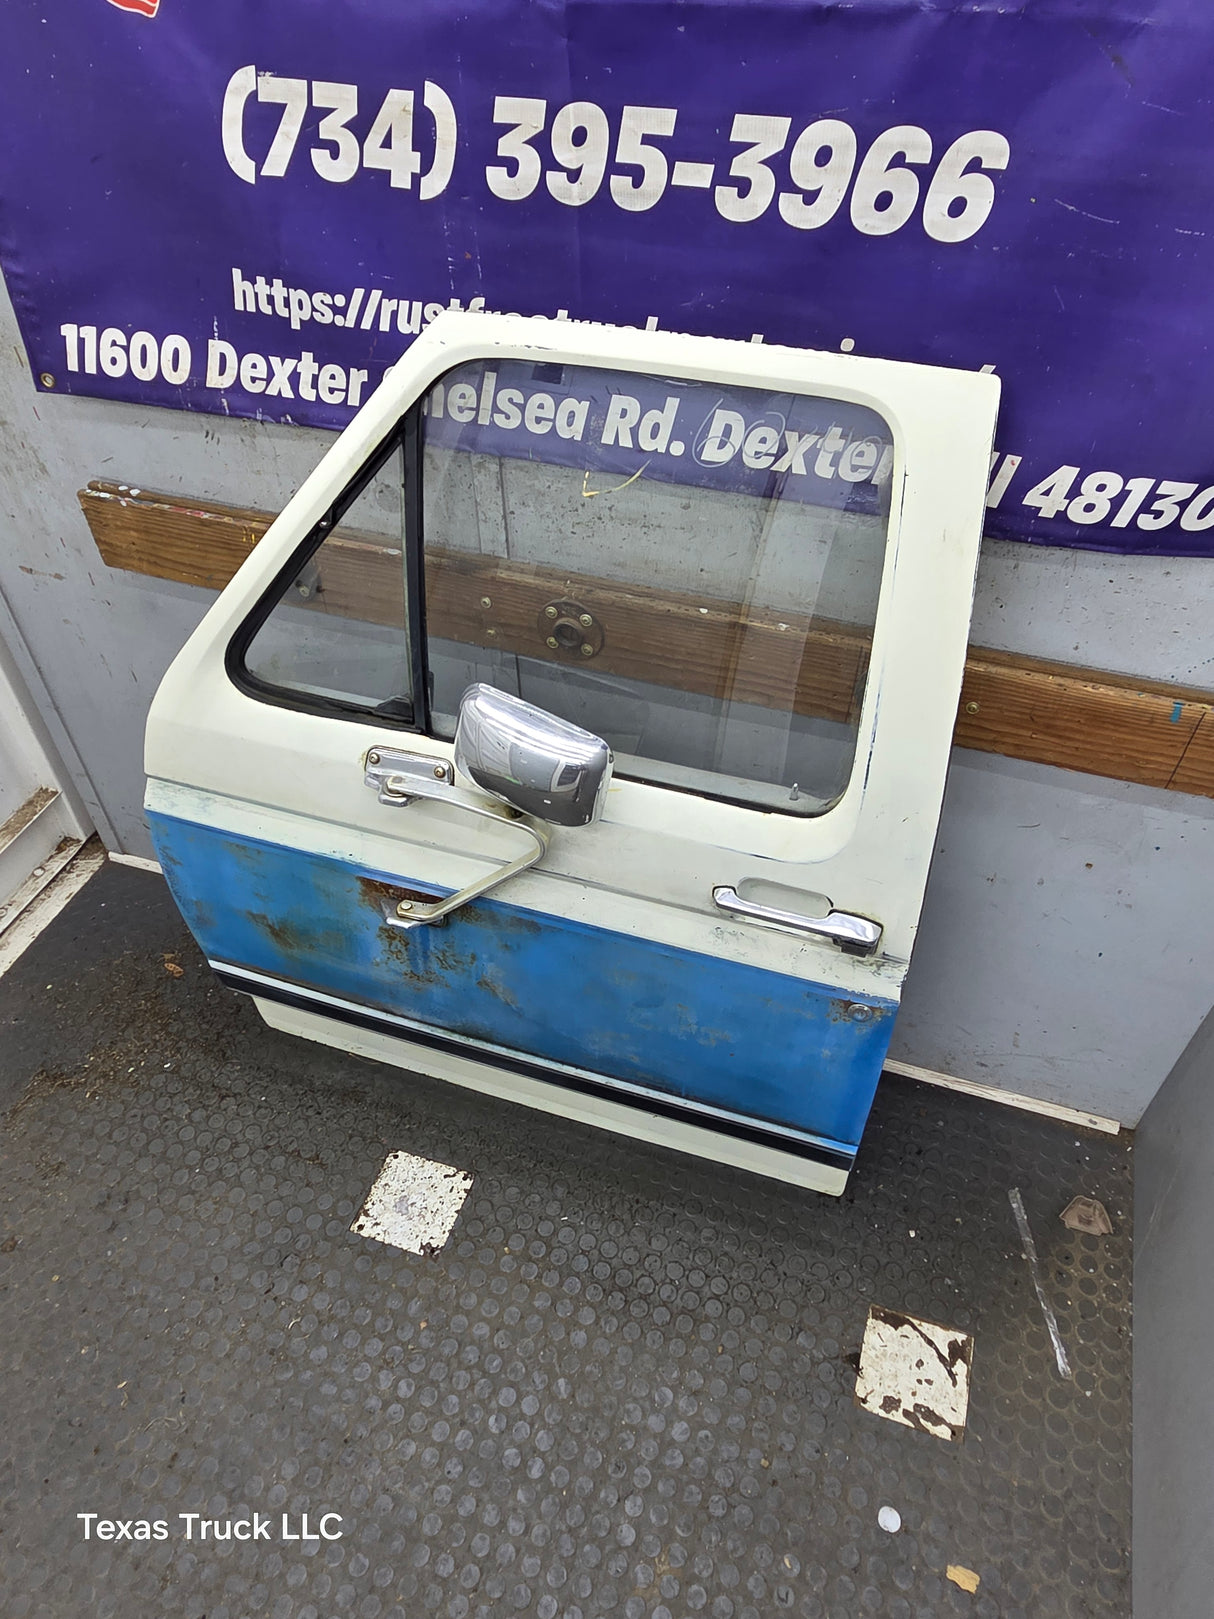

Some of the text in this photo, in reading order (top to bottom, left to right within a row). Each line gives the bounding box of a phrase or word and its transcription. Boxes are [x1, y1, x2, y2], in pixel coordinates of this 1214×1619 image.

[222, 65, 1011, 243] (734) 395-3966
[61, 324, 192, 385] 11600
[206, 339, 368, 407] Dexter
[383, 366, 590, 441] elsea
[601, 394, 685, 456] Rd.
